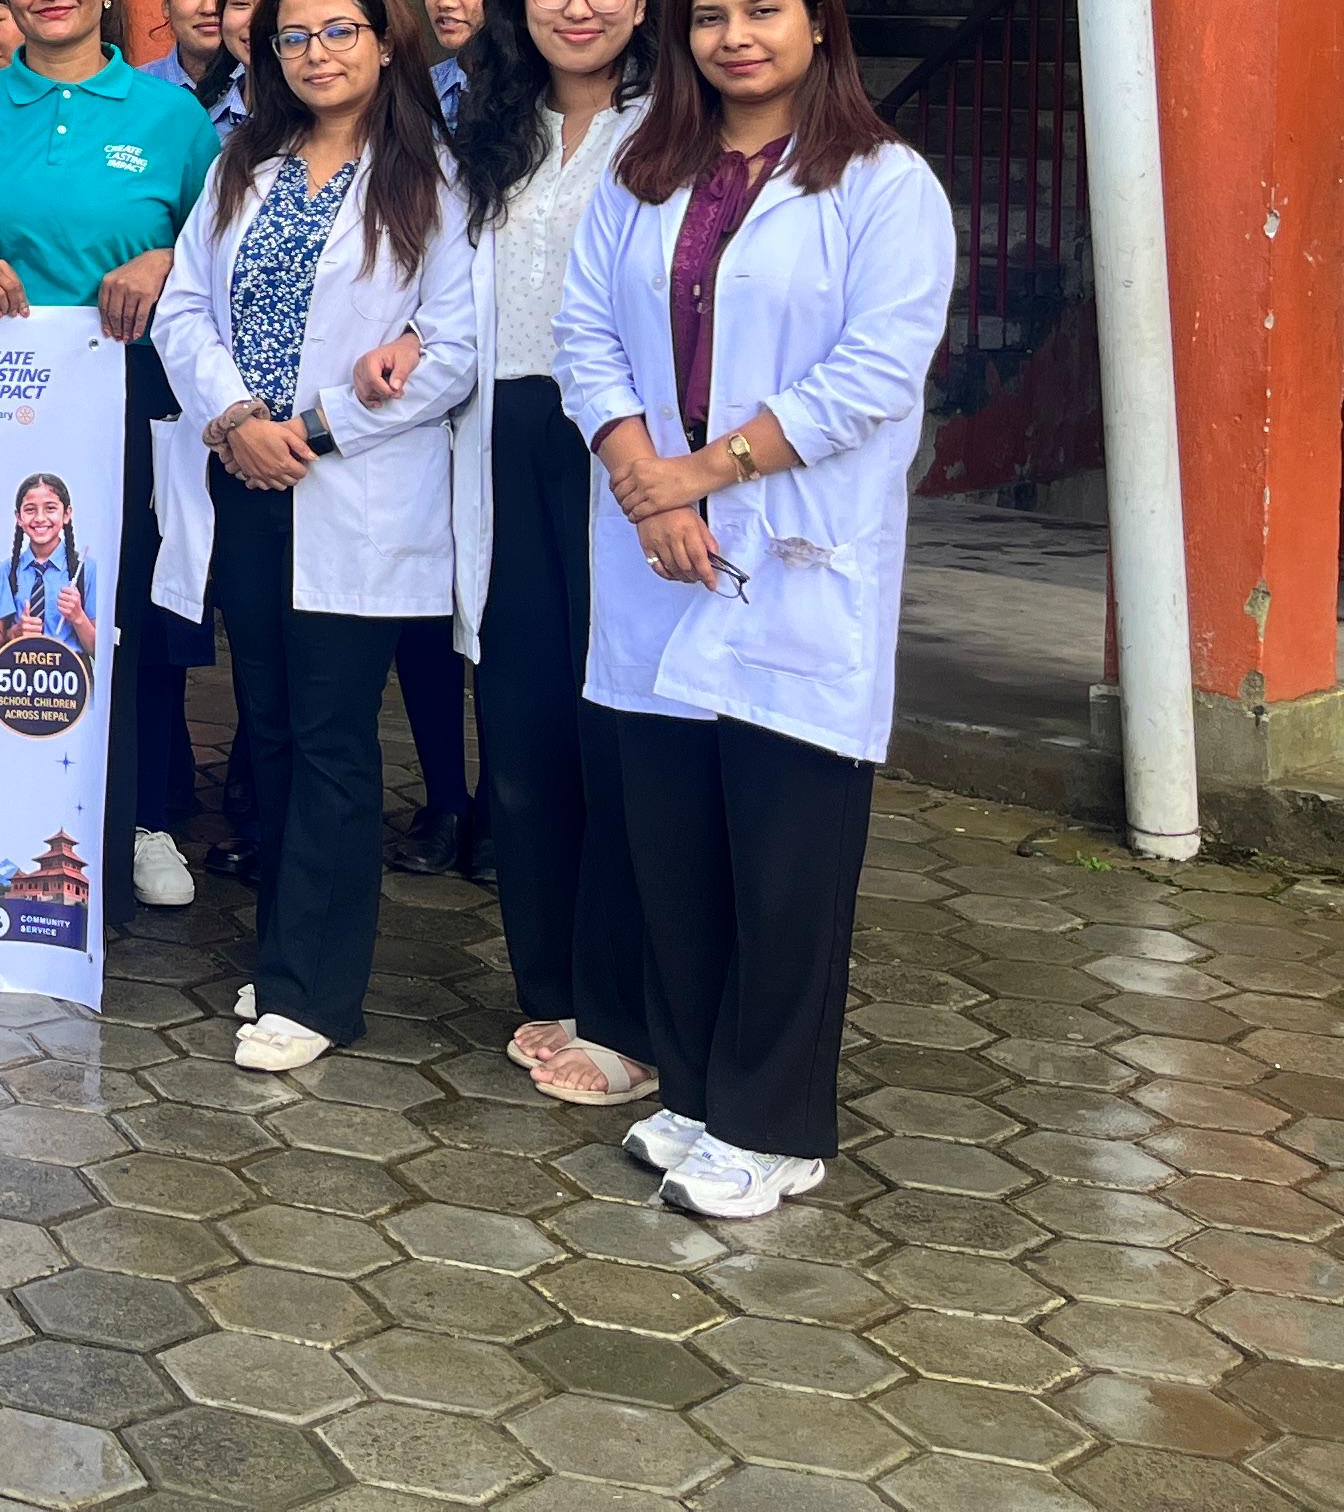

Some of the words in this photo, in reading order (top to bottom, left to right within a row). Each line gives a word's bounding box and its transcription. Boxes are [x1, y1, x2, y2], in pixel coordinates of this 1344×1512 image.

[12, 651, 62, 666] TARGET
[5, 709, 40, 720] ACROSS
[41, 711, 70, 723] NEPAL
